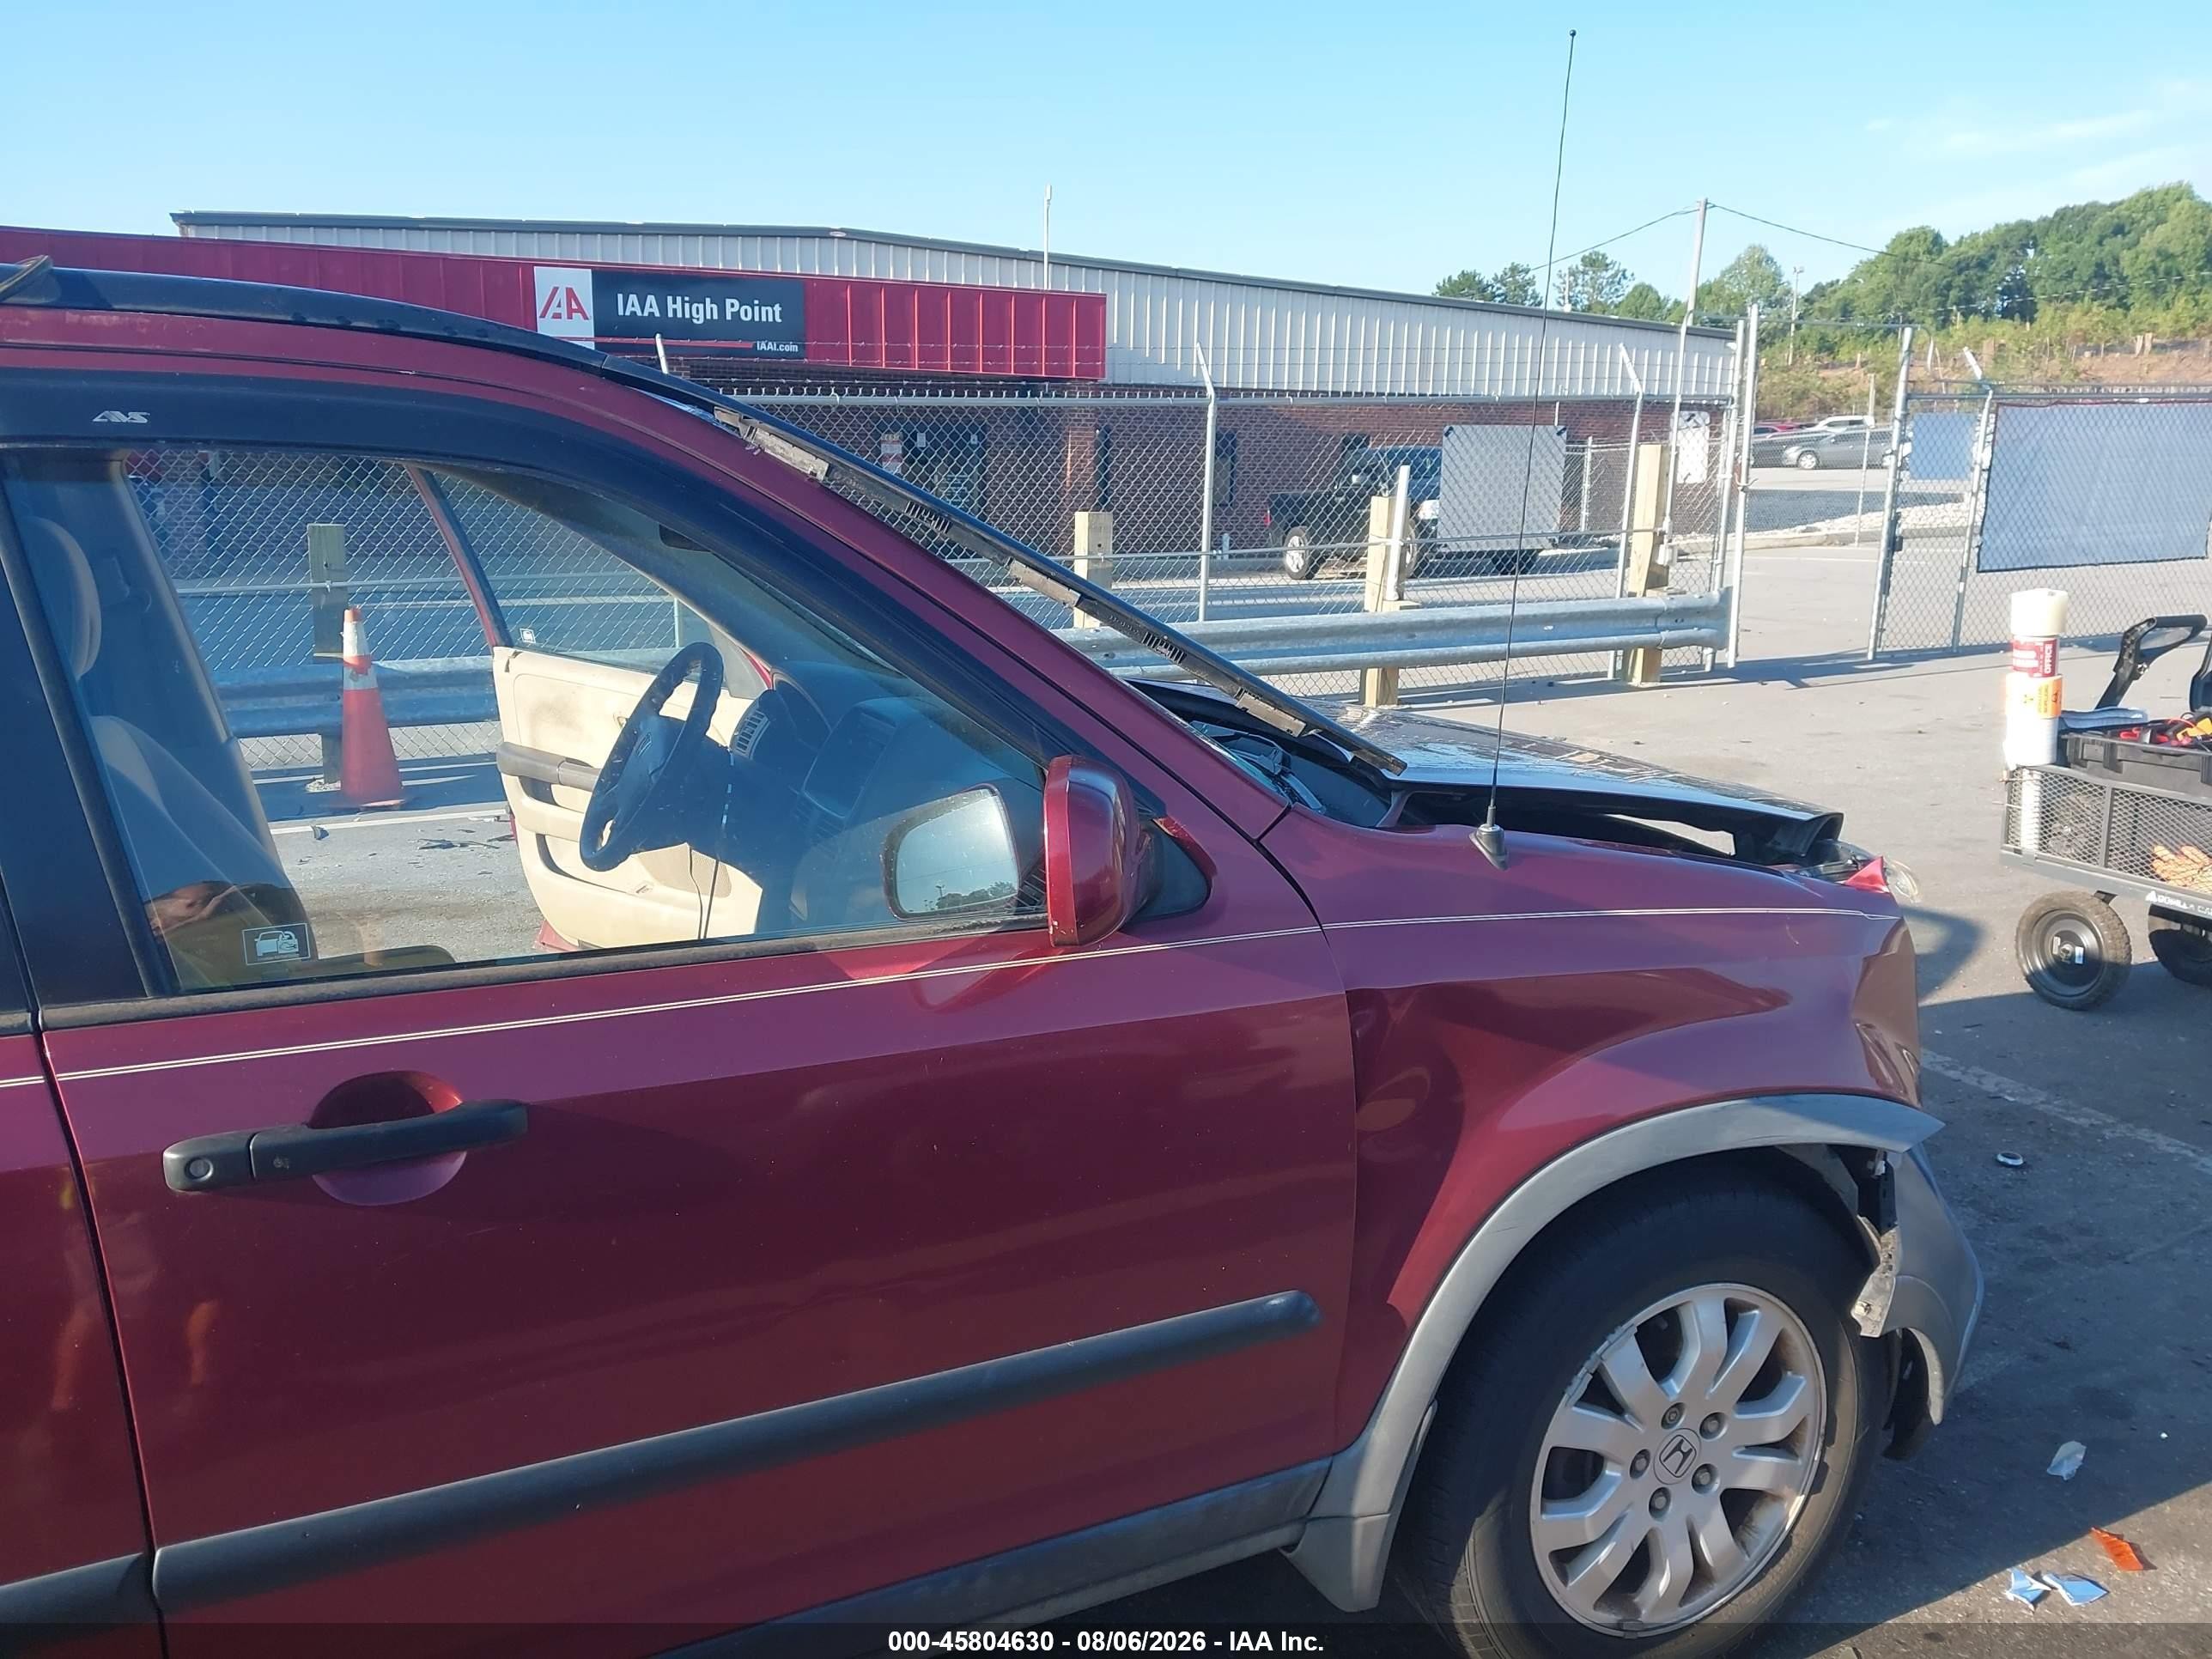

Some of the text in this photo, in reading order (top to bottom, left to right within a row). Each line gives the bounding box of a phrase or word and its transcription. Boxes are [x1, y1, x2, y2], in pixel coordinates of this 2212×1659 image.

[617, 293, 782, 325] IAA High Point
[757, 340, 799, 352] IAAI.com
